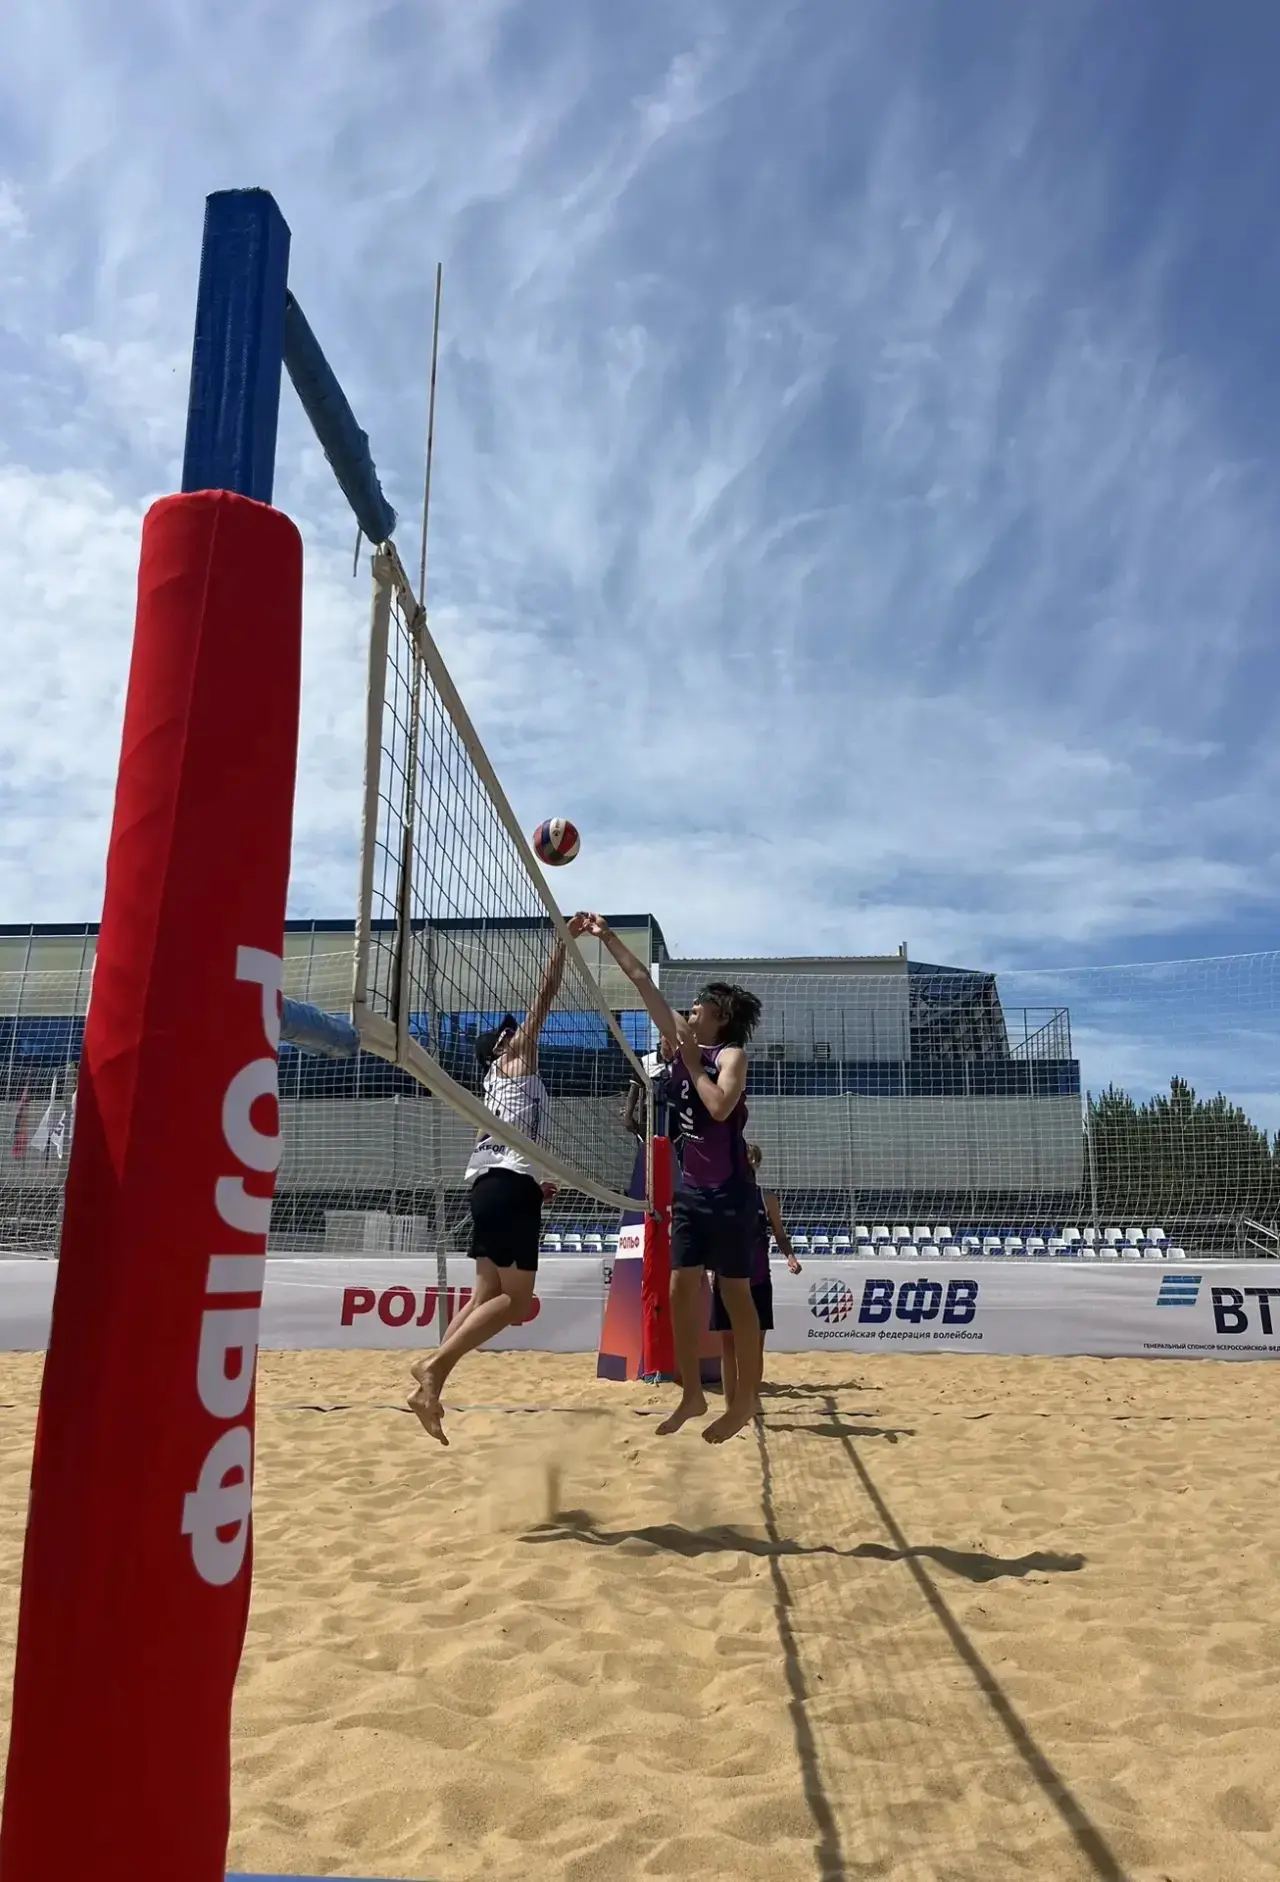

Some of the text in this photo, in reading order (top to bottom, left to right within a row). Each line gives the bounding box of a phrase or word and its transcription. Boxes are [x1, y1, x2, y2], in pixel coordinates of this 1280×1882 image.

[681, 1080, 689, 1099] 2
[858, 1278, 979, 1324] ВФВ
[807, 1329, 983, 1341] Всероссийская федерация волейбола
[1216, 1344, 1267, 1352] ВСЕРОССИЙСКОЙ
